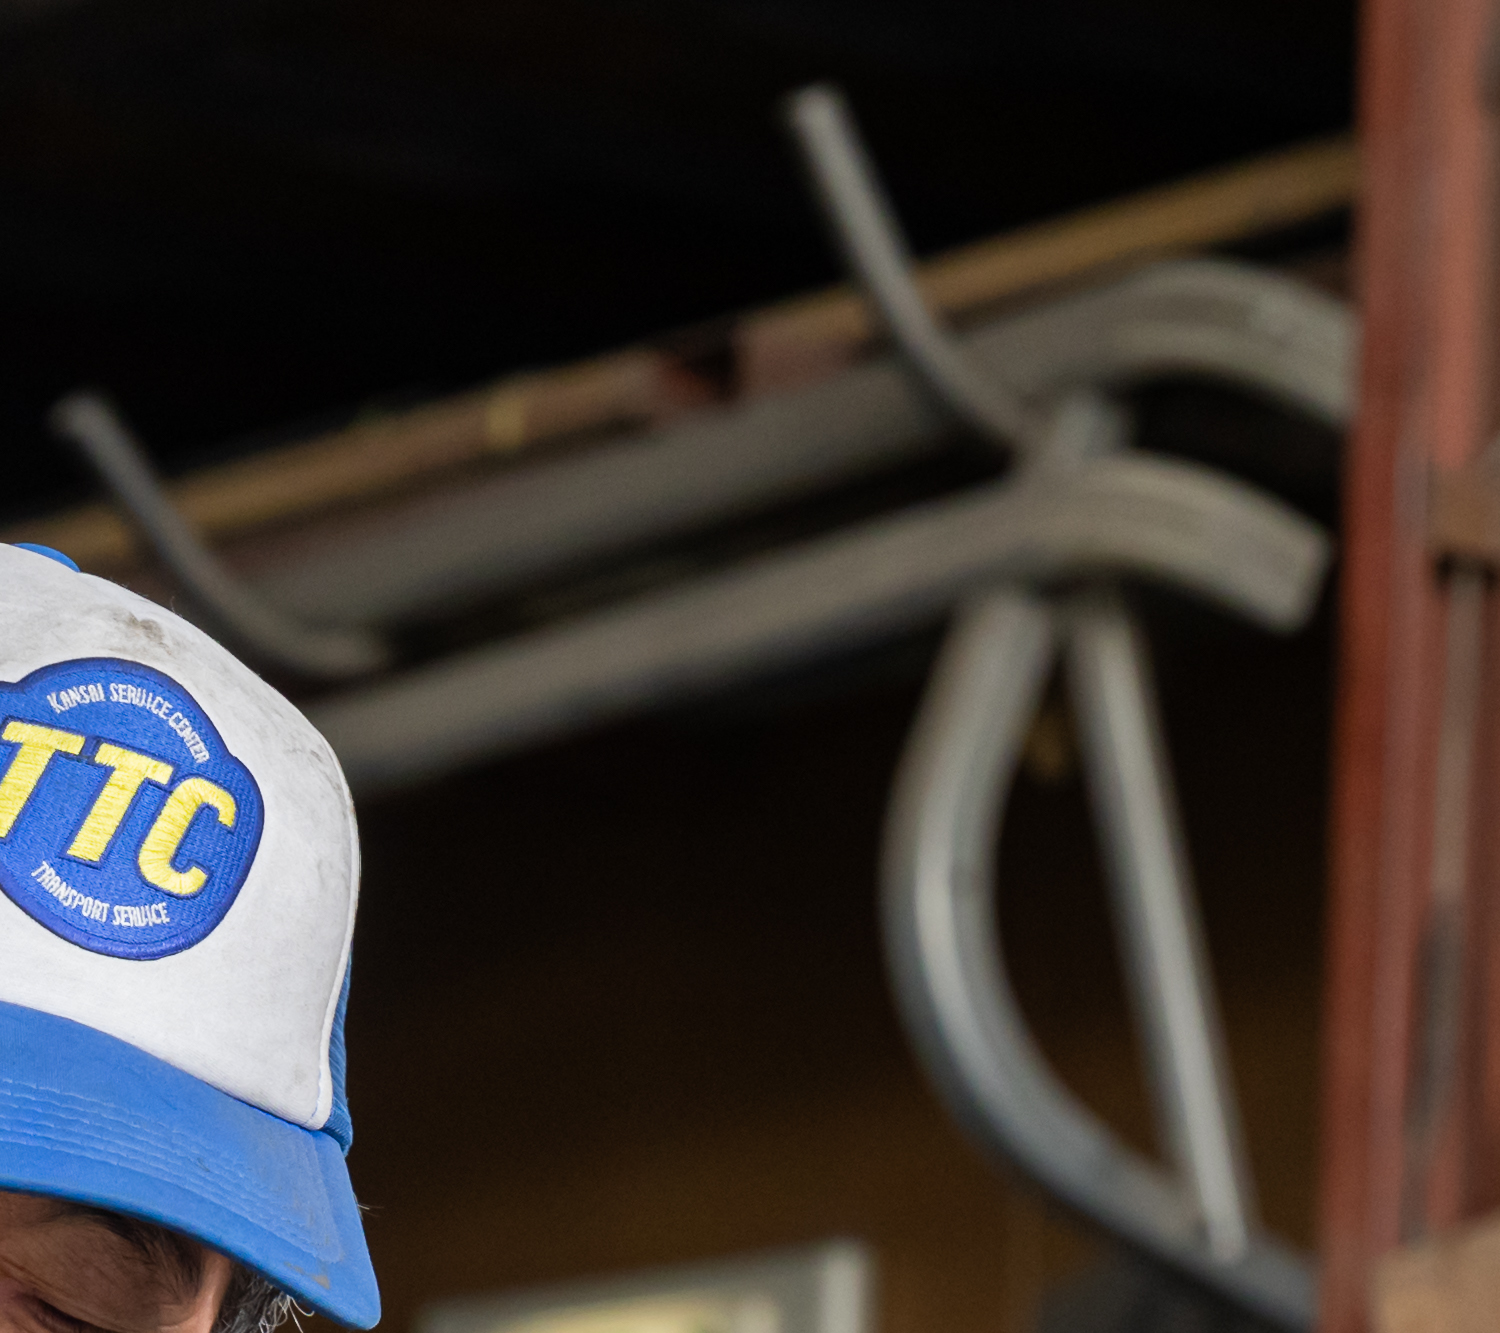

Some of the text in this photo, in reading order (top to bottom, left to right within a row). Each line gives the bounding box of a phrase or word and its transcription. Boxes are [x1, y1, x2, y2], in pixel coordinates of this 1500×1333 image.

[47, 682, 210, 764] KANSAI SERVICE CENTER
[31, 860, 170, 927] TRANSPORT SERVICE
